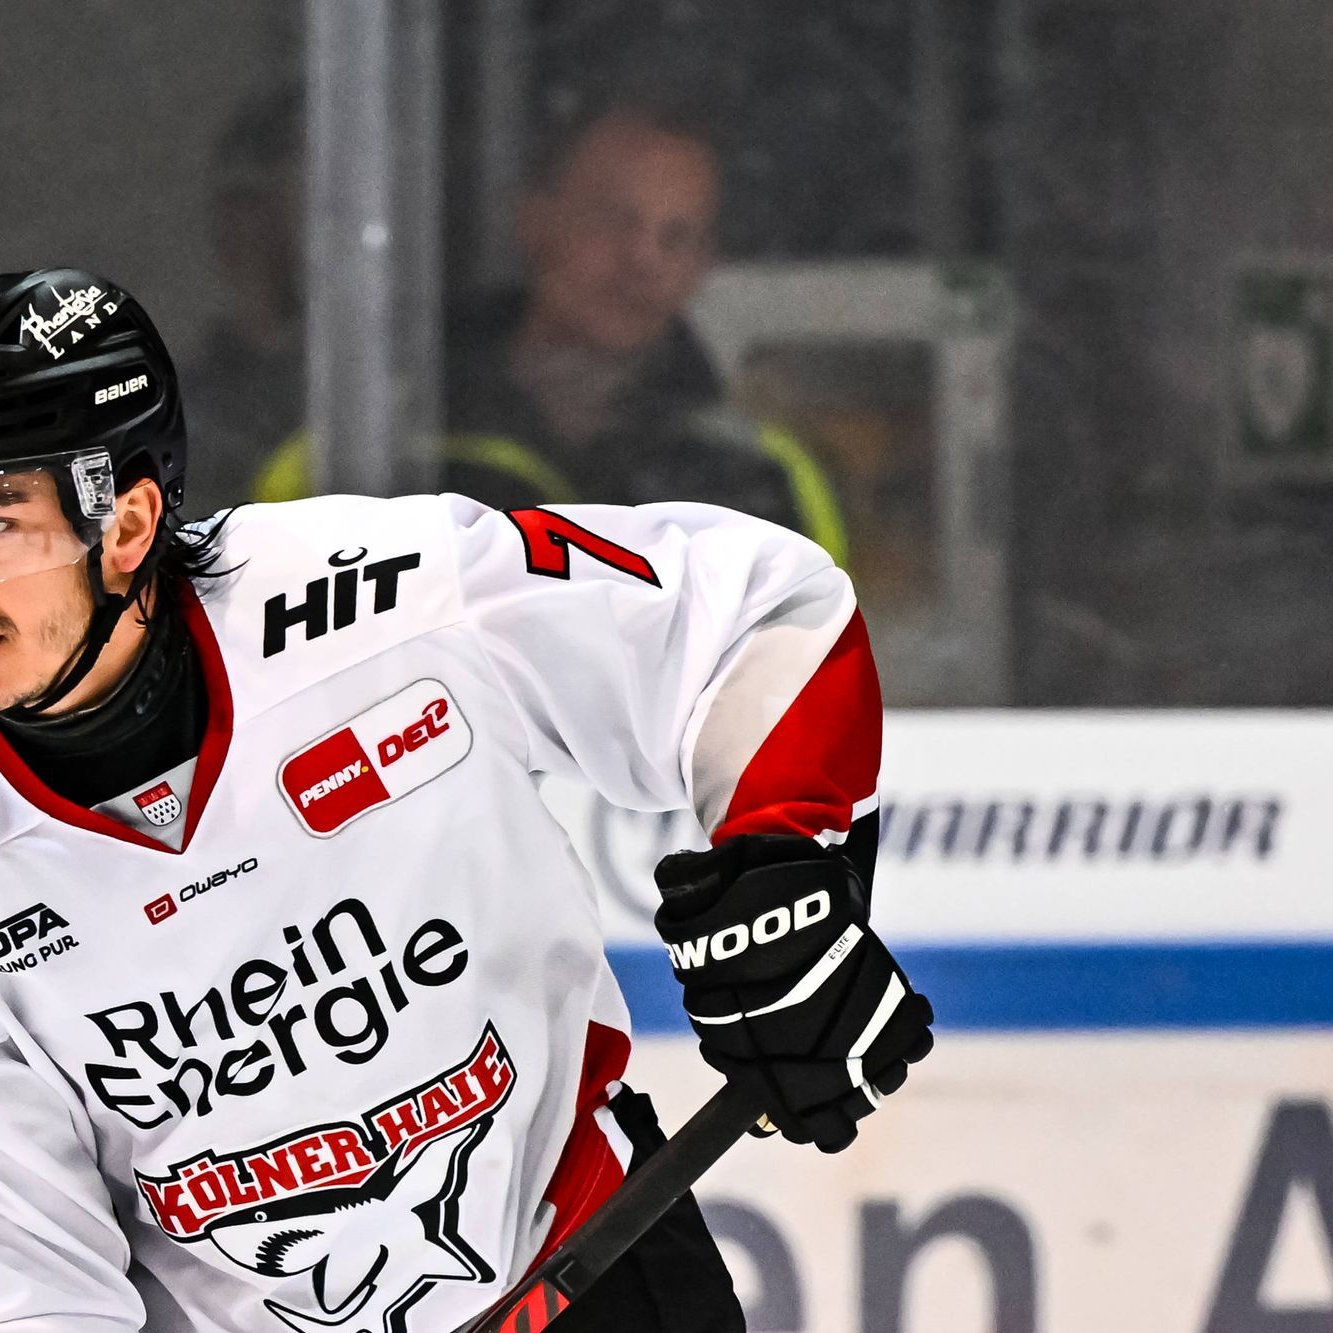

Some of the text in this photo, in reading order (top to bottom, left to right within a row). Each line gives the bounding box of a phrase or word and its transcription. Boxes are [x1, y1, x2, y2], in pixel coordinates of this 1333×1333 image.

[52, 301, 118, 359] LAND
[94, 374, 149, 405] BAUER
[502, 506, 663, 589] 7
[262, 547, 422, 659] HIT
[179, 856, 259, 902] owayo
[85, 897, 388, 1067] Rhein
[827, 934, 851, 960] E-LITE
[85, 916, 470, 1130] Energie
[140, 1035, 515, 1236] KÖLNER HAIE
